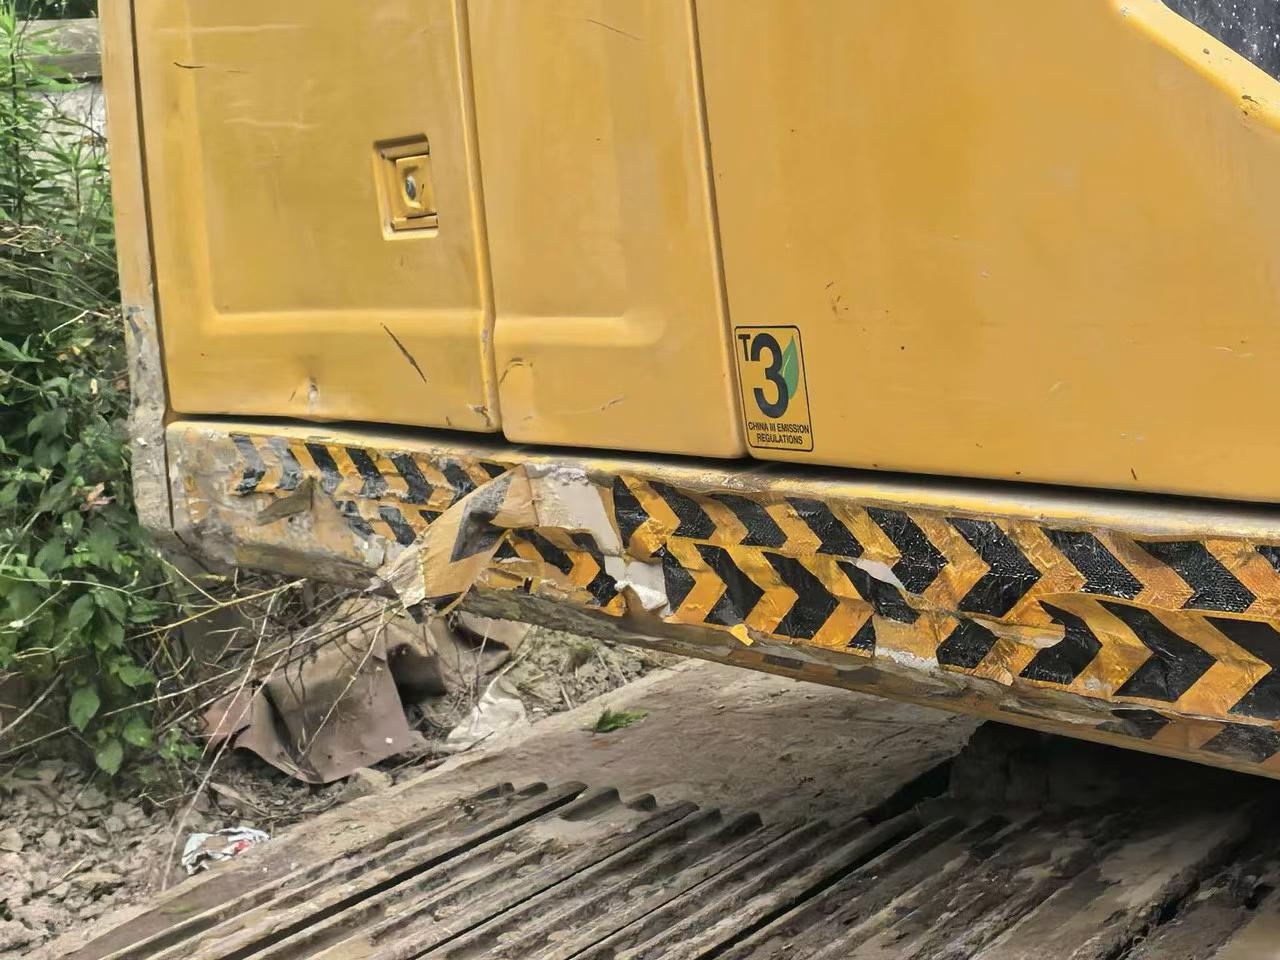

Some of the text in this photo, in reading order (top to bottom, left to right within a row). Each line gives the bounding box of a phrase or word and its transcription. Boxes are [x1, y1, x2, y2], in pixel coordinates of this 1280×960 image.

[748, 422, 769, 431] CHINA
[777, 423, 810, 434] EMISSION
[757, 433, 803, 445] REGULATIONS
